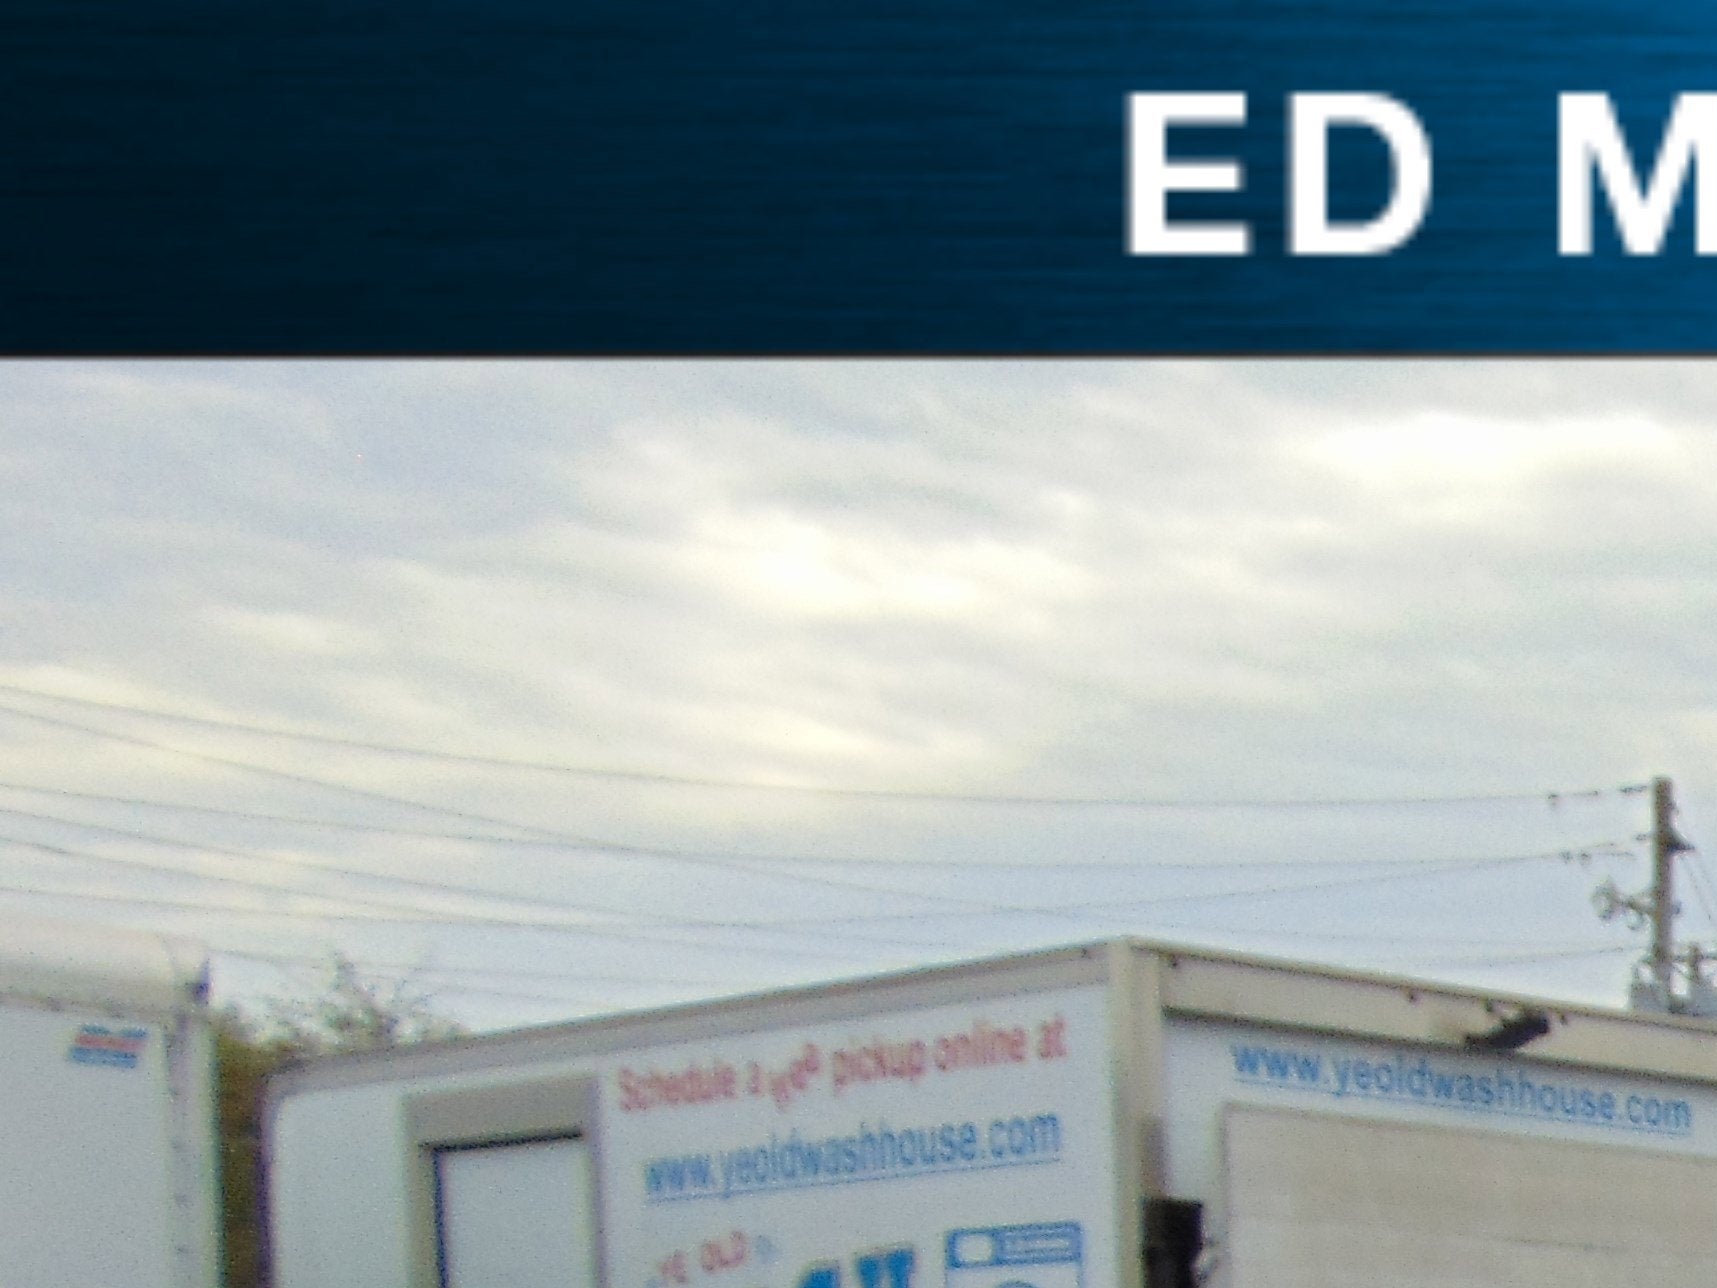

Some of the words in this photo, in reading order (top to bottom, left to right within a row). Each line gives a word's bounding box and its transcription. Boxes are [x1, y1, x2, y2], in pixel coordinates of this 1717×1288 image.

[617, 1060, 737, 1112] Schedule
[833, 1038, 926, 1092] pickup
[934, 1018, 1028, 1072] online
[1037, 1014, 1066, 1060] at
[1232, 1044, 1692, 1136] www.yeoldwashhouse.com
[644, 1112, 1063, 1200] www.yeoldwashhouse.com
